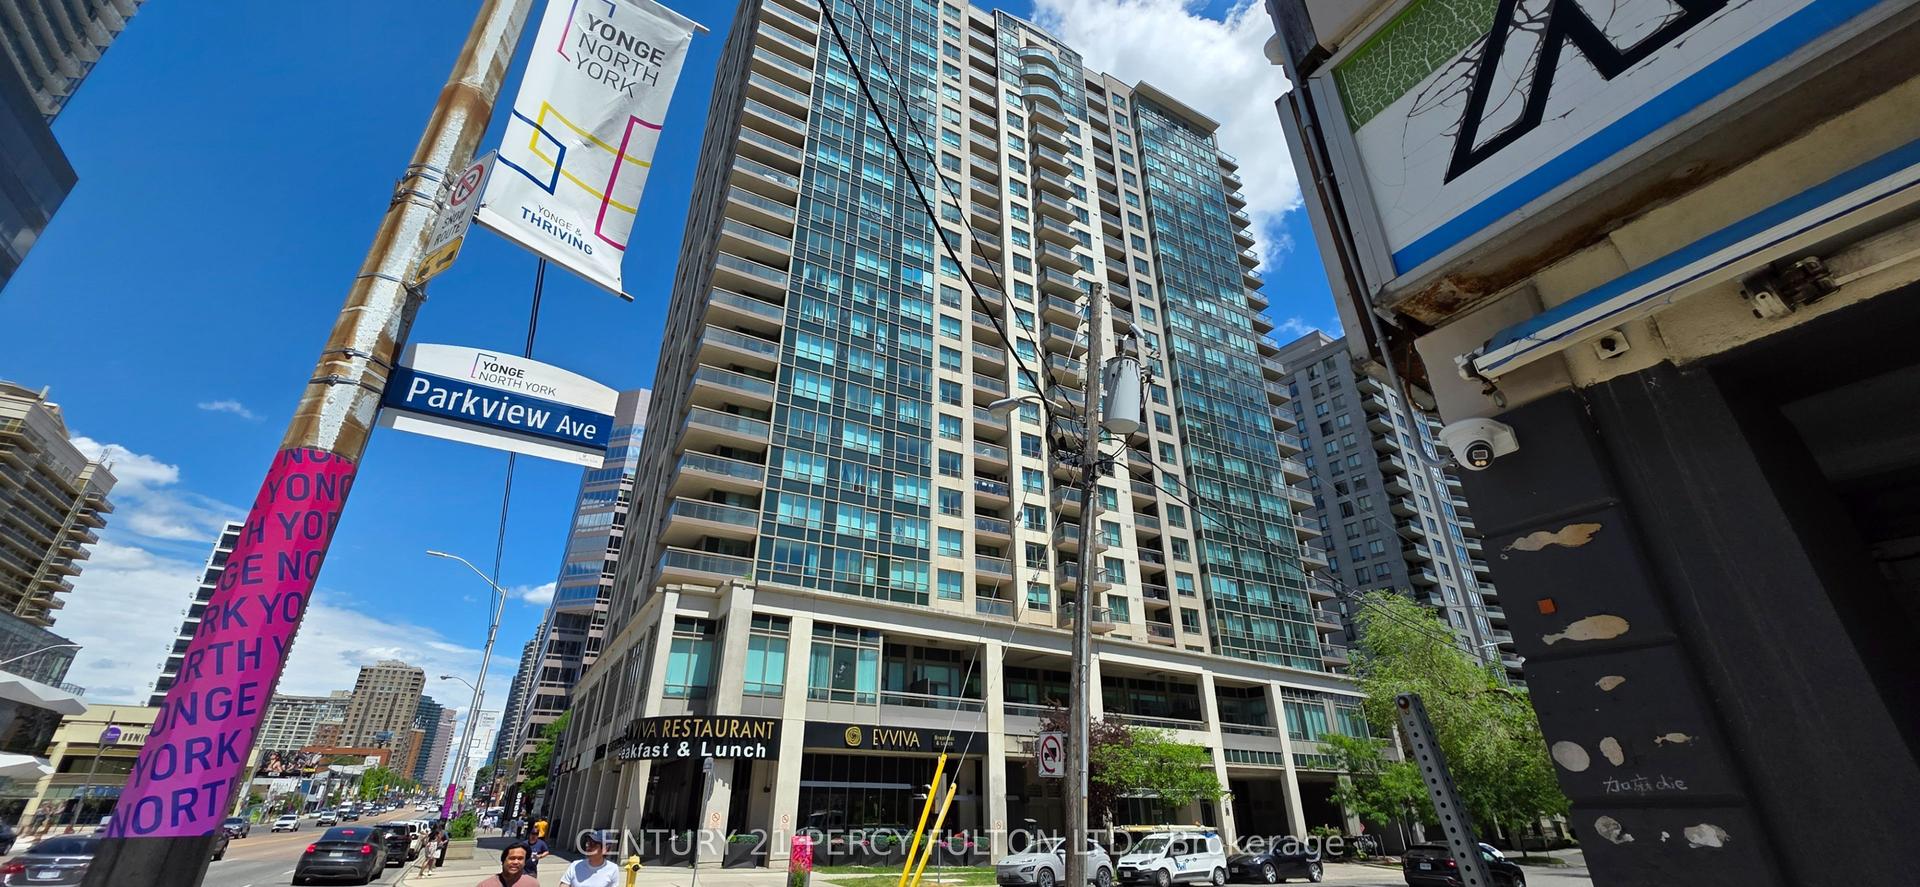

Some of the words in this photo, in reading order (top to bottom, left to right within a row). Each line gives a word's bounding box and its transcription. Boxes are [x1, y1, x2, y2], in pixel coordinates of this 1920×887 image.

[588, 13, 666, 67] YONGE
[576, 51, 638, 99] YORK
[578, 32, 660, 88] NORTH
[434, 221, 463, 246] ROUTE
[521, 206, 593, 255] THRIVING
[537, 205, 573, 230] YONGE
[575, 228, 582, 236] &
[478, 371, 522, 389] NORTH
[525, 382, 557, 396] YORK
[483, 361, 525, 379] YONGE
[406, 376, 550, 430] Parkview
[556, 415, 597, 440] Ave
[662, 718, 774, 739] RESTAURANT
[872, 728, 920, 748] EVVIVA
[134, 728, 242, 789] YORK
[619, 741, 669, 760] eakfast
[676, 741, 691, 757] &
[701, 741, 766, 758] Lunch
